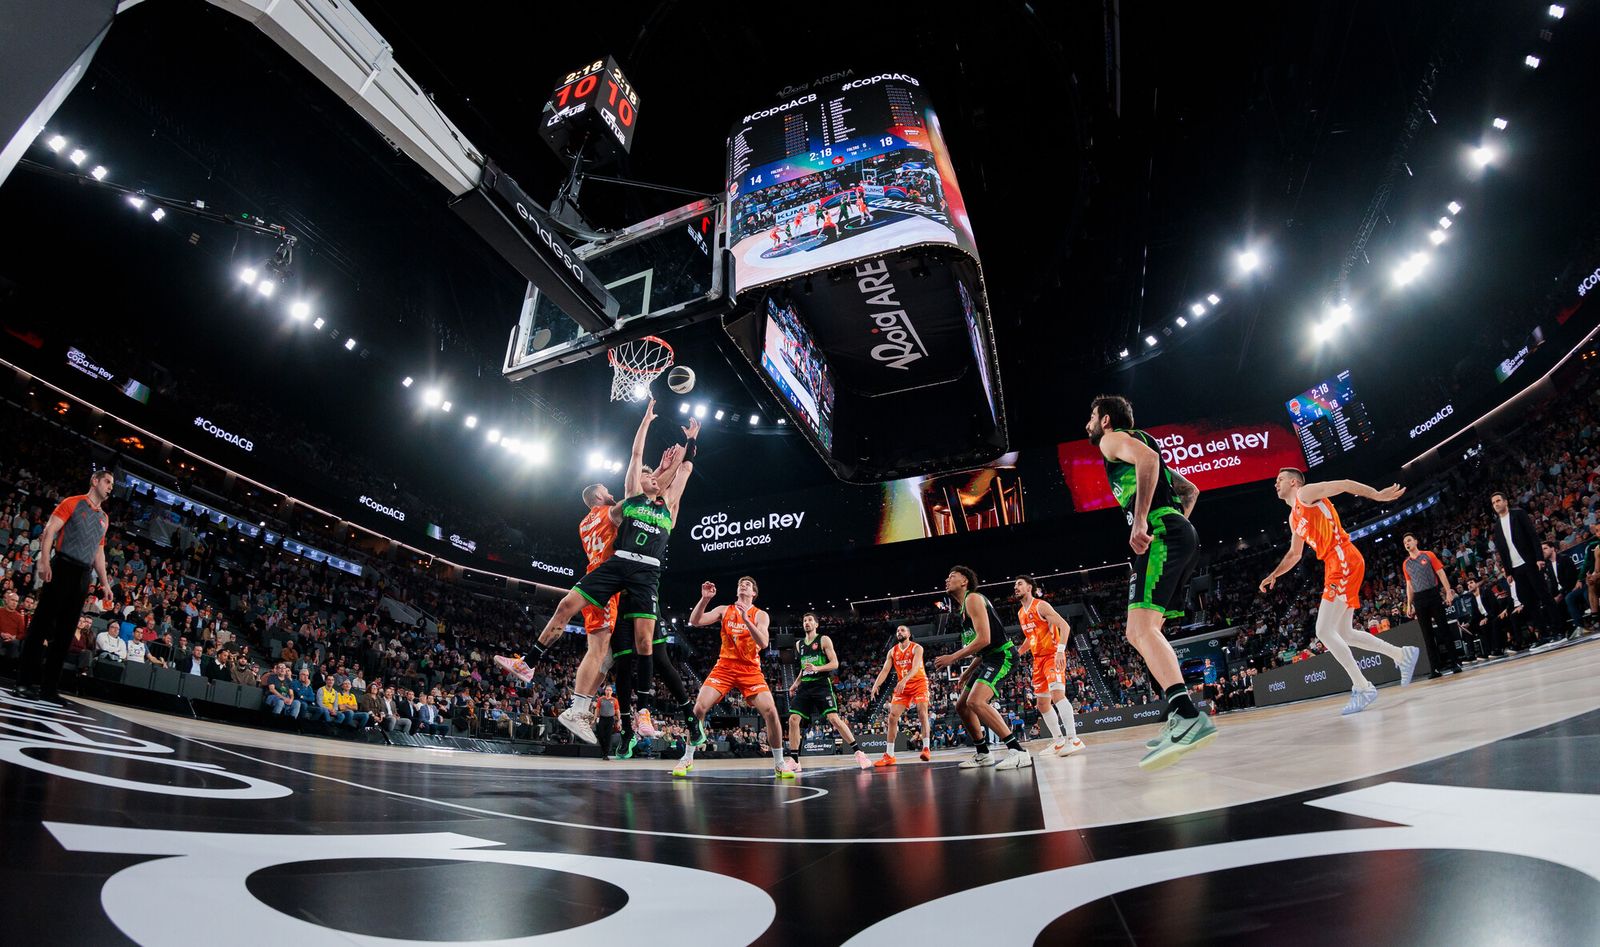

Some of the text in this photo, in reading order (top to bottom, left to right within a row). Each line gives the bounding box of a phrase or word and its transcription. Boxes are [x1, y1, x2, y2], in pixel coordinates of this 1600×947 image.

[564, 60, 604, 84] 2:18
[813, 68, 854, 87] ARENA
[557, 75, 597, 106] 10
[613, 68, 637, 105] 2:18
[841, 72, 920, 91] #CopaACB
[608, 79, 633, 127] 10
[742, 93, 818, 125] #CopaACB
[879, 136, 894, 148] 18
[809, 147, 832, 162] 2:18
[750, 174, 763, 186] 14
[516, 201, 584, 283] endesa
[66, 351, 90, 368] Copa
[98, 367, 115, 381] Rey
[1311, 383, 1329, 400] 2:18
[1313, 407, 1324, 418] 14
[1328, 399, 1339, 410] 18
[1409, 404, 1454, 439] #CopaACB
[193, 416, 254, 452] #CopaACB
[1160, 431, 1270, 464] opa del Rey
[1212, 455, 1242, 469] 2026
[359, 494, 406, 522] #CopaACB
[690, 511, 805, 541] Copa del Rey
[701, 511, 728, 526] acb
[635, 532, 648, 546] 0
[701, 534, 771, 552] Valencia 2026
[531, 559, 575, 577] #CopaACB
[1304, 669, 1327, 685] endesa
[1268, 680, 1286, 693] endesa
[1094, 715, 1122, 726] endesa
[1133, 708, 1161, 720] endesa
[861, 740, 888, 748] endesa
